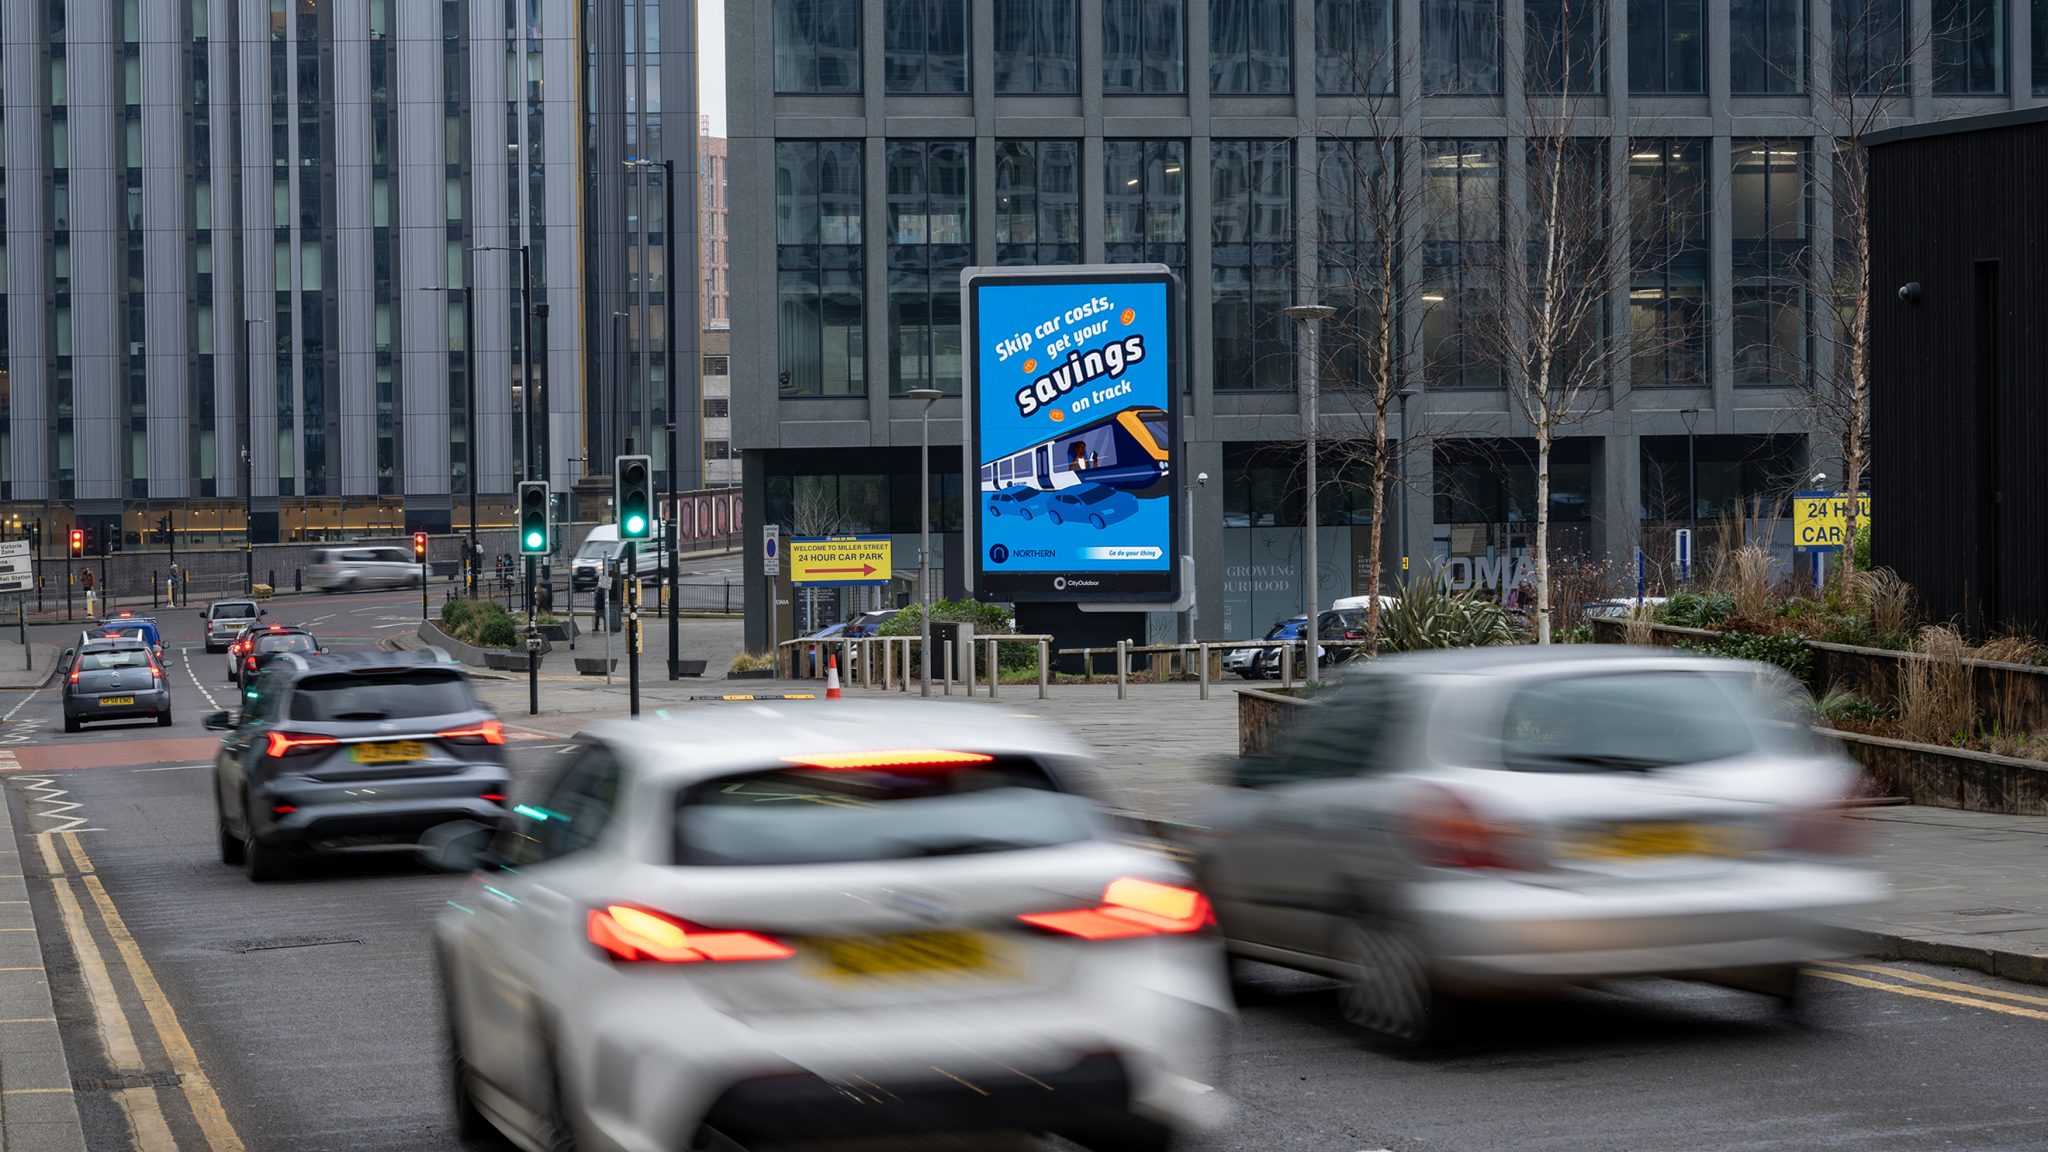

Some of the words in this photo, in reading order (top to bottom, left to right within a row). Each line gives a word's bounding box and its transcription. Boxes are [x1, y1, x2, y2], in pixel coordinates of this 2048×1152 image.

[995, 334, 1032, 361] Skip
[1035, 316, 1061, 339] car
[1064, 297, 1115, 325] costs,
[1047, 334, 1071, 360] get
[1073, 320, 1109, 346] your
[1017, 336, 1143, 416] savings
[1071, 397, 1091, 413] on
[1093, 379, 1132, 405] track
[1807, 502, 1828, 518] 24
[1802, 526, 1841, 543] CAR
[798, 554, 808, 562] 24
[810, 553, 836, 561] HOUR
[838, 553, 857, 561] CAR
[859, 552, 884, 560] PARK
[1013, 549, 1056, 558] NORTHERN
[1140, 549, 1156, 557] thing
[1226, 565, 1295, 577] GROWING
